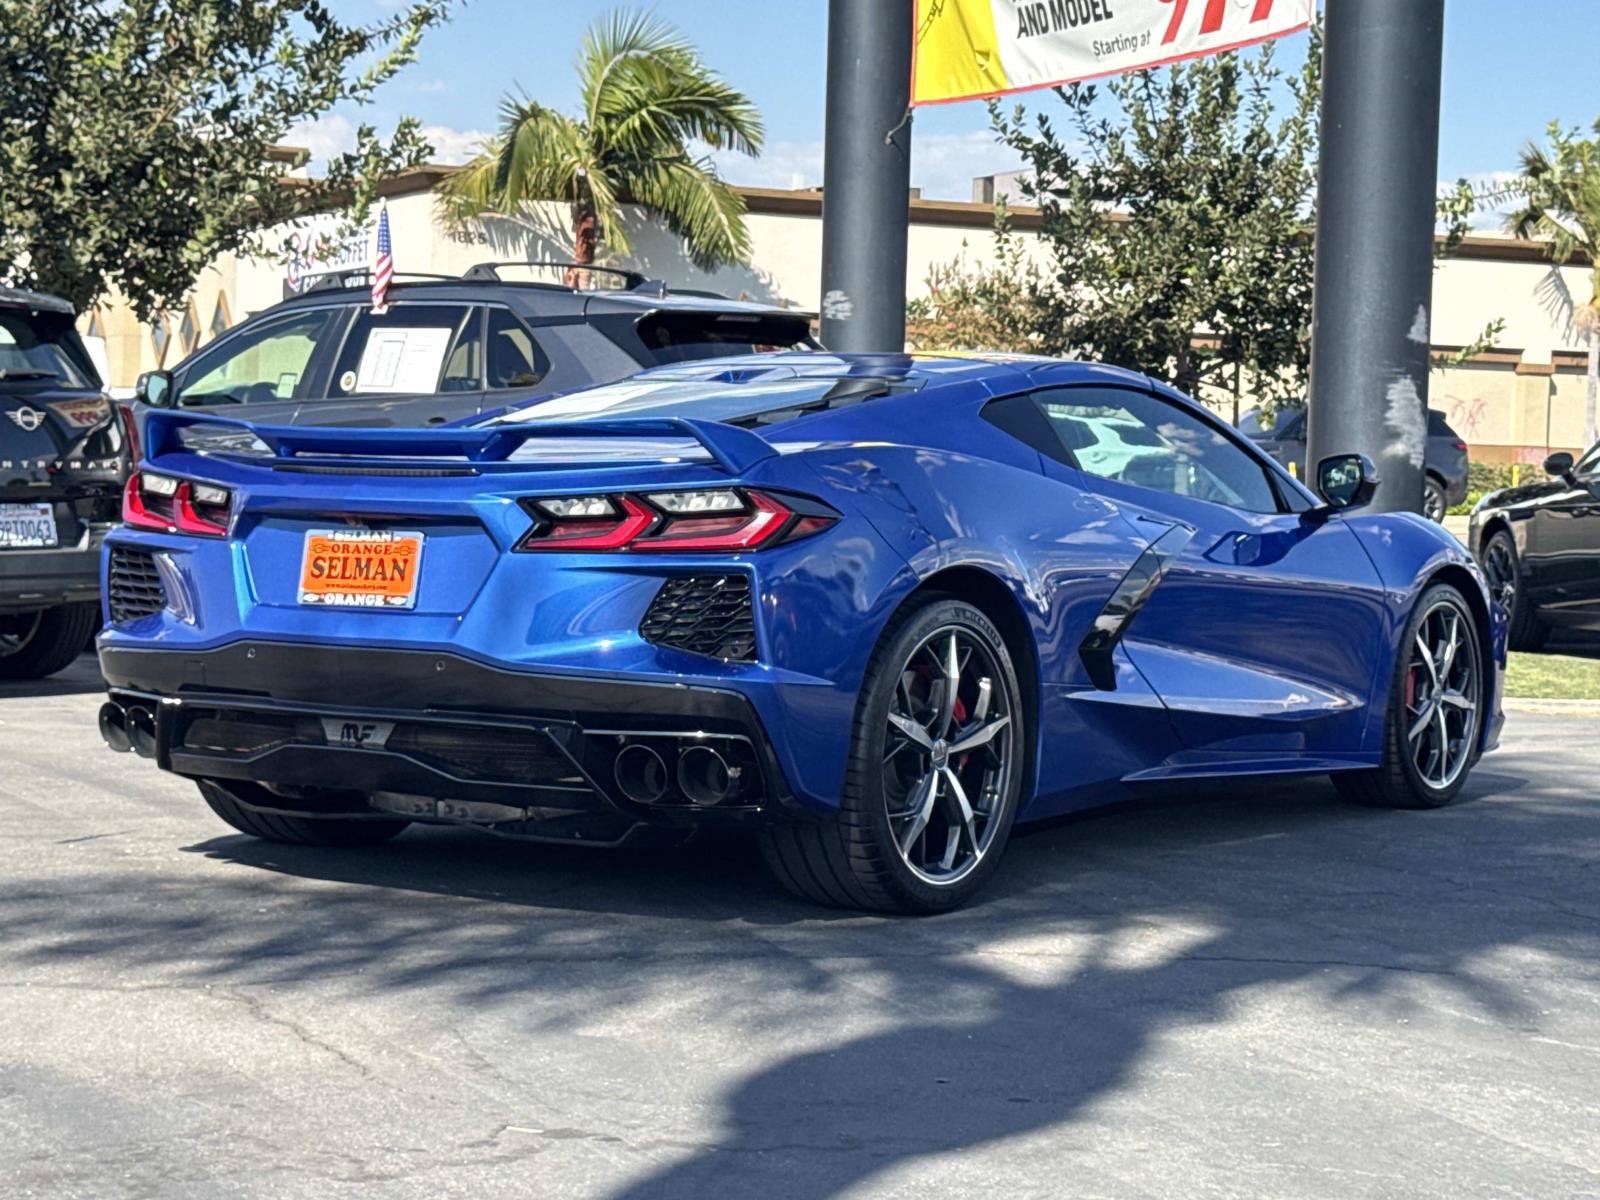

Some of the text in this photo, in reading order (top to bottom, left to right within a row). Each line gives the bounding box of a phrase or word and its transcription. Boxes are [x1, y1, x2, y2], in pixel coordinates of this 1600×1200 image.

[1016, 0, 1113, 39] AND MODEL
[1092, 29, 1151, 56] Starting at
[331, 543, 393, 556] ORANGE
[310, 556, 409, 582] SELMAN
[324, 593, 385, 606] ORANGE
